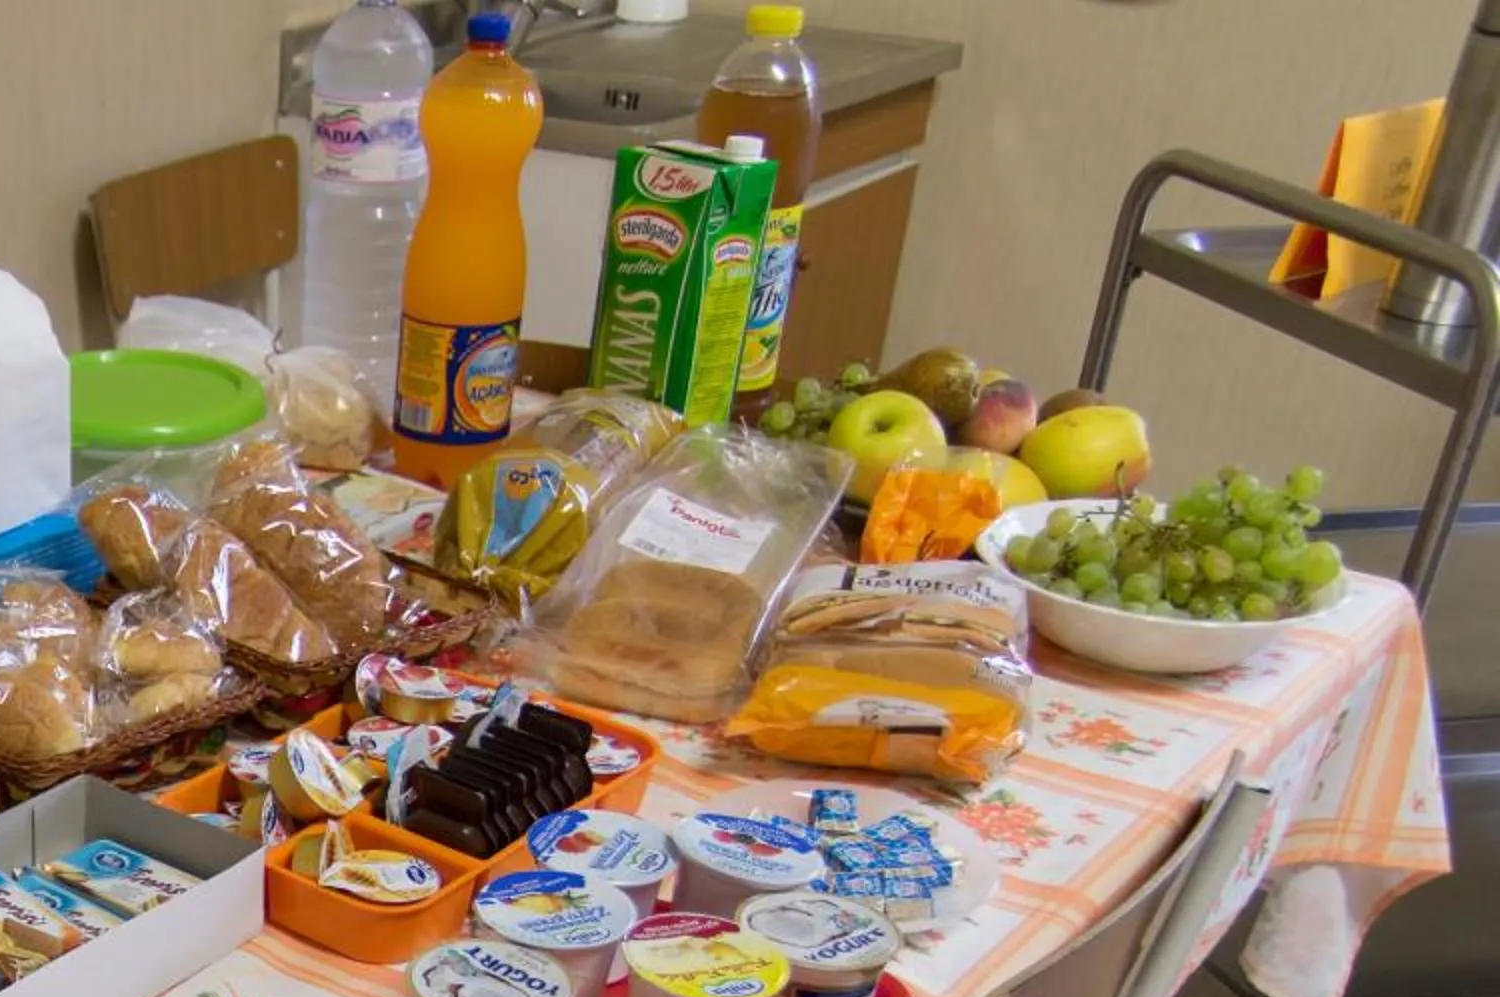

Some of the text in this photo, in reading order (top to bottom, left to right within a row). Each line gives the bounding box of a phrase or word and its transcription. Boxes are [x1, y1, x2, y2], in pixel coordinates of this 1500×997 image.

[620, 216, 680, 248] sterilgarda
[602, 284, 662, 392] NANAS
[467, 945, 560, 997] YOGURT
